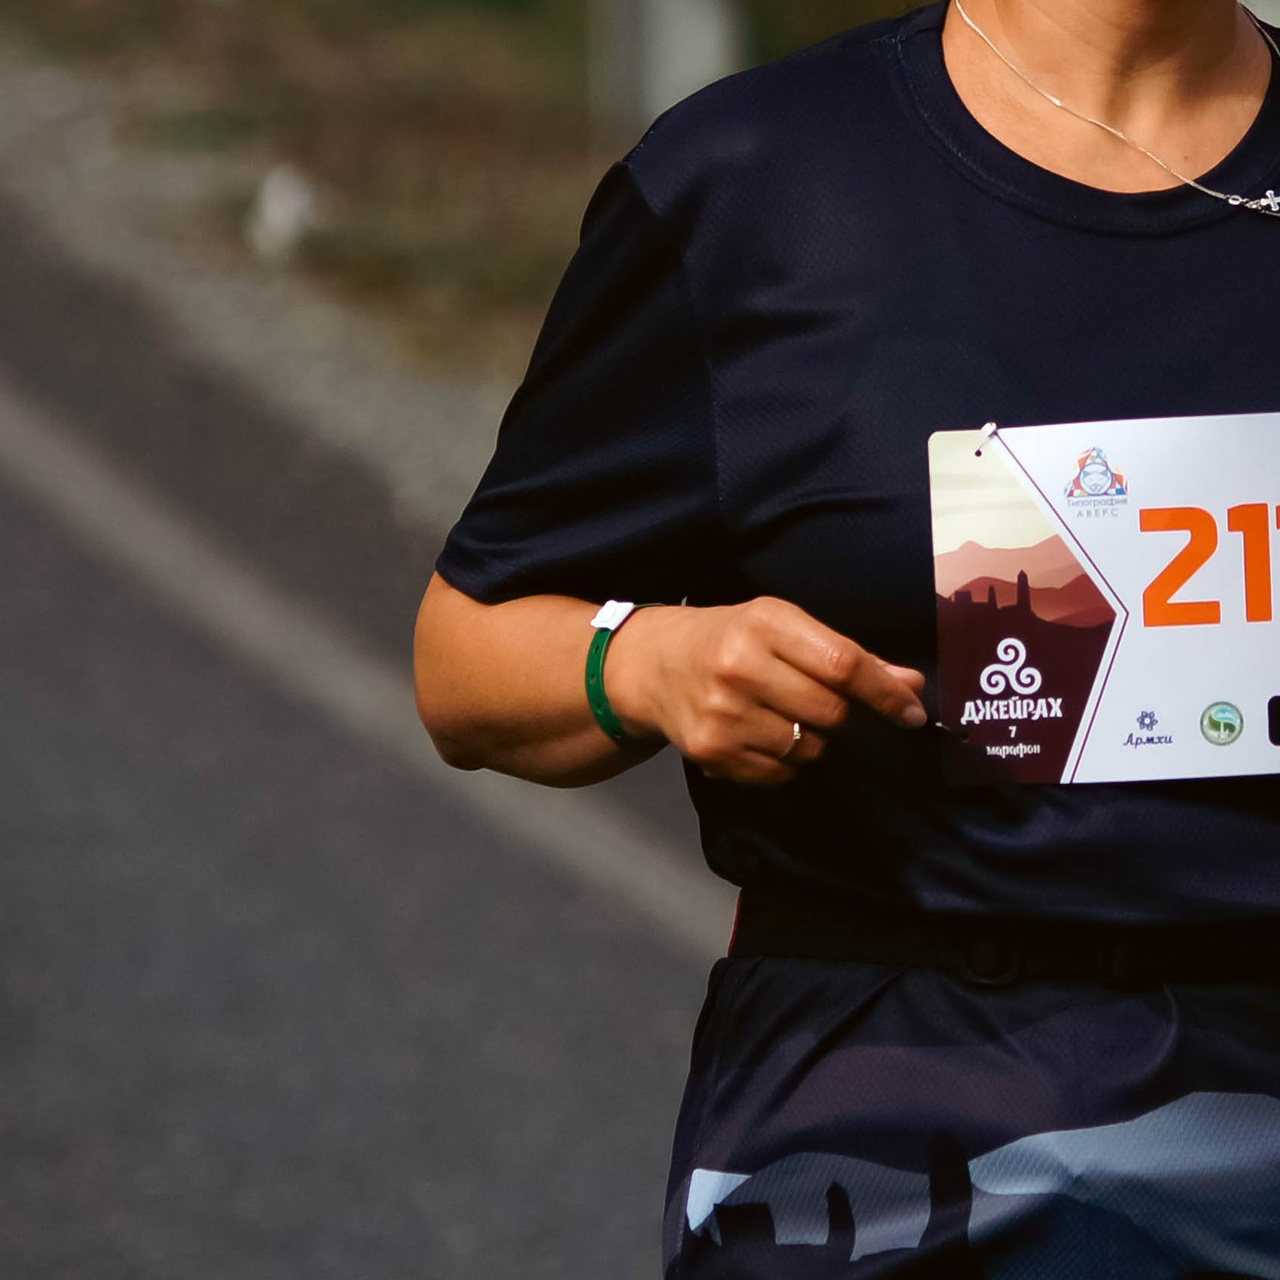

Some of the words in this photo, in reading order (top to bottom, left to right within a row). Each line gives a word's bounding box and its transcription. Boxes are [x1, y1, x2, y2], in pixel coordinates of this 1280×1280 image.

[960, 696, 1062, 725] ДЖЕЙРАХ
[1009, 725, 1018, 738] 7
[1123, 732, 1173, 749] Армхи
[986, 743, 1041, 759] марафон
